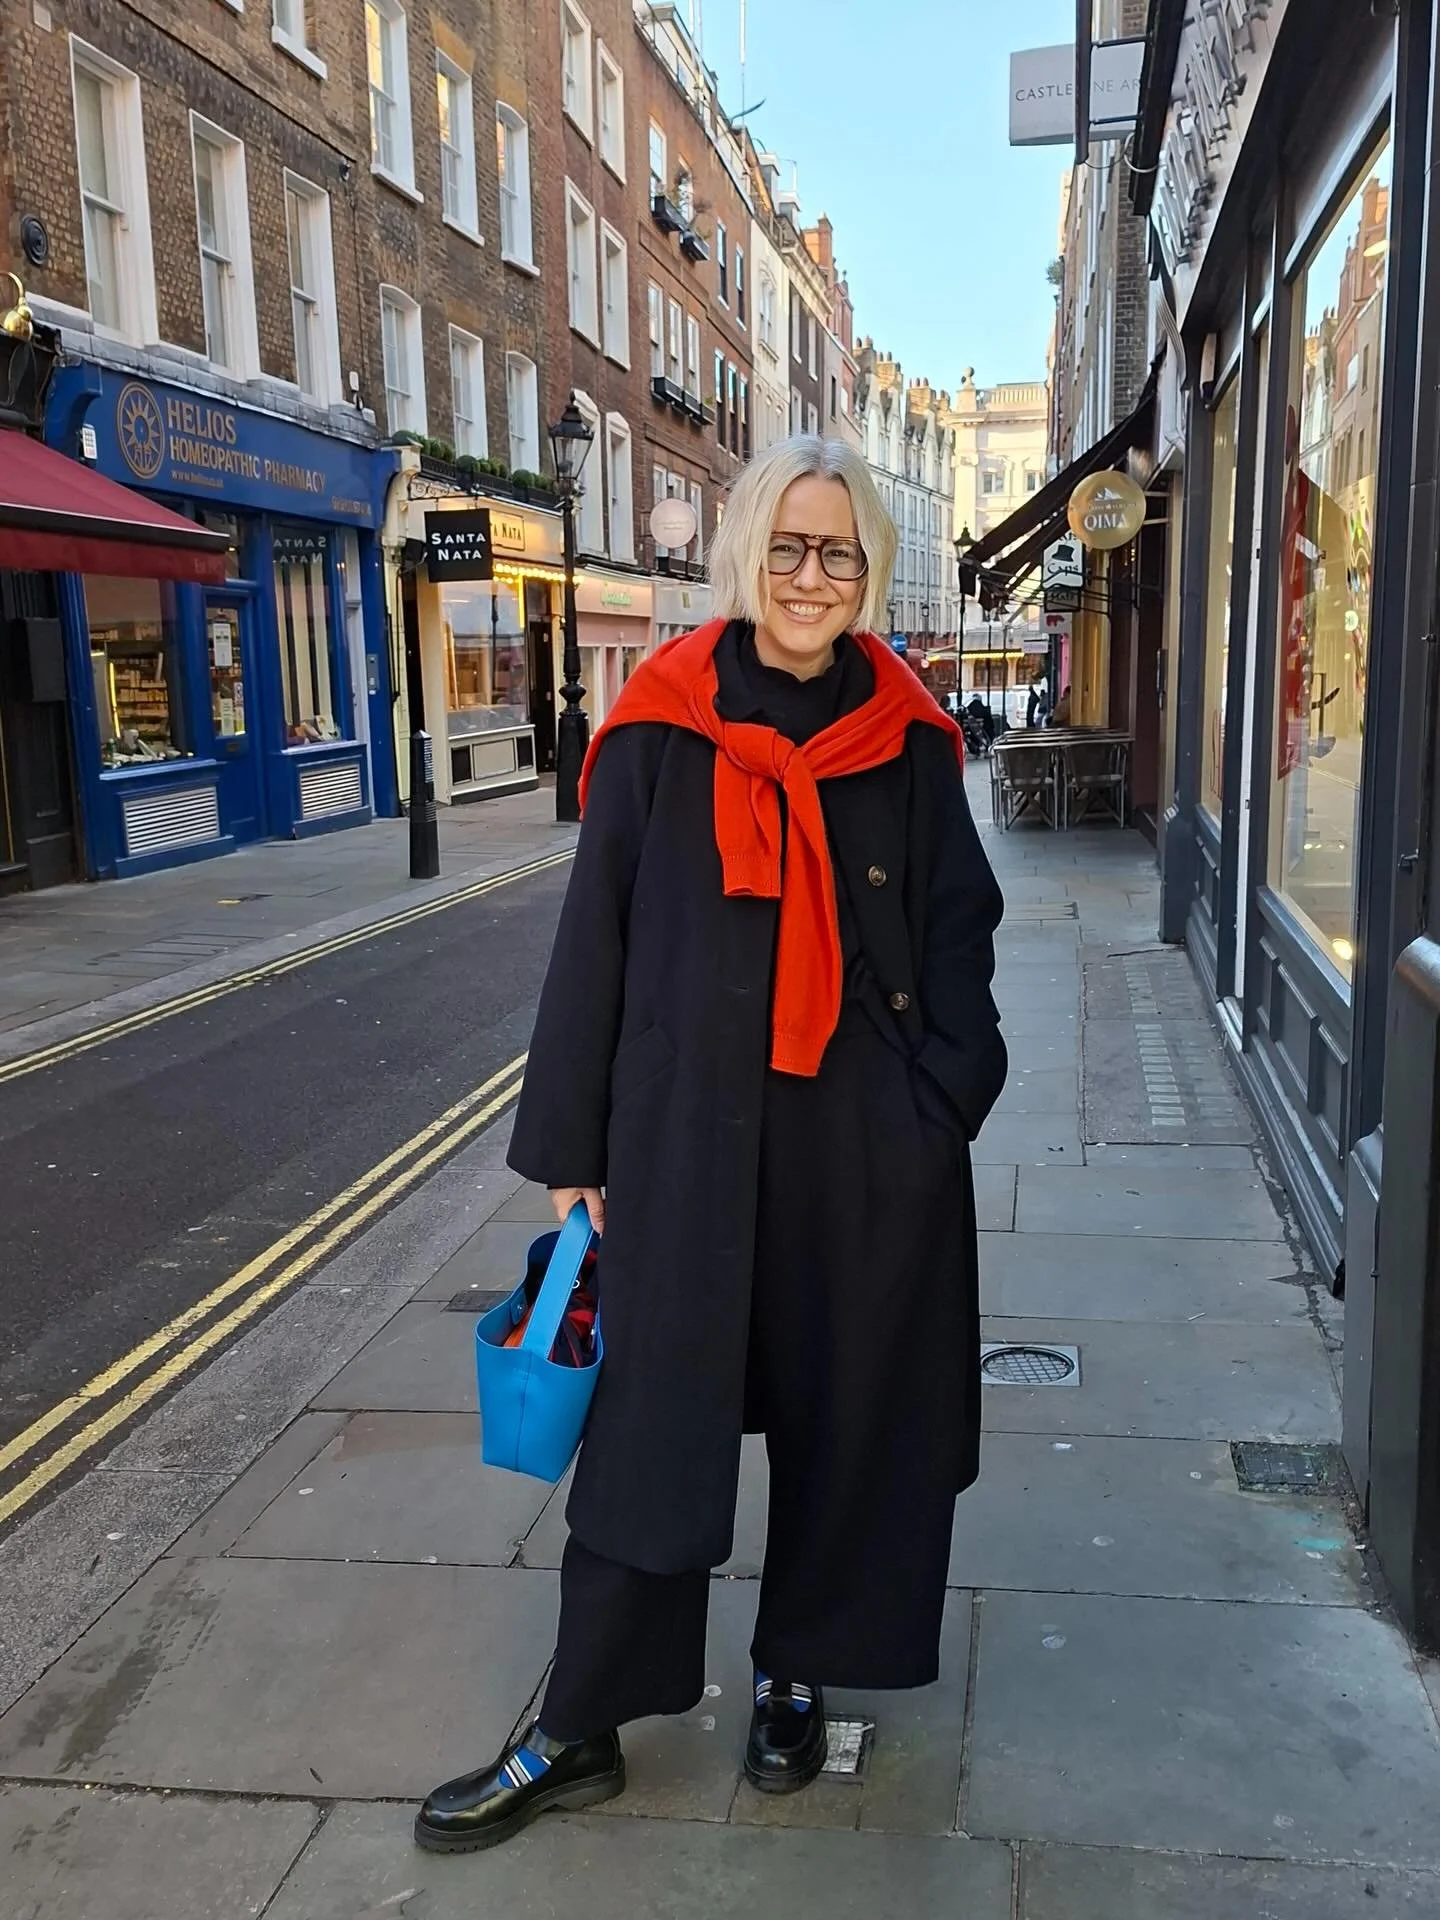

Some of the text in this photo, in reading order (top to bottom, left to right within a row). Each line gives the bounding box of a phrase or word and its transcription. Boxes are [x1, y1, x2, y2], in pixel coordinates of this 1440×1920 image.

[1015, 83, 1073, 102] CASTLE
[1093, 80, 1113, 93] NE
[166, 397, 237, 445] HELIOS
[169, 435, 261, 480] HOMEOPATHIC
[264, 458, 325, 493] PHARMACY
[1083, 513, 1128, 532] QIMA
[431, 532, 486, 545] SANTA
[437, 548, 482, 561] NATA
